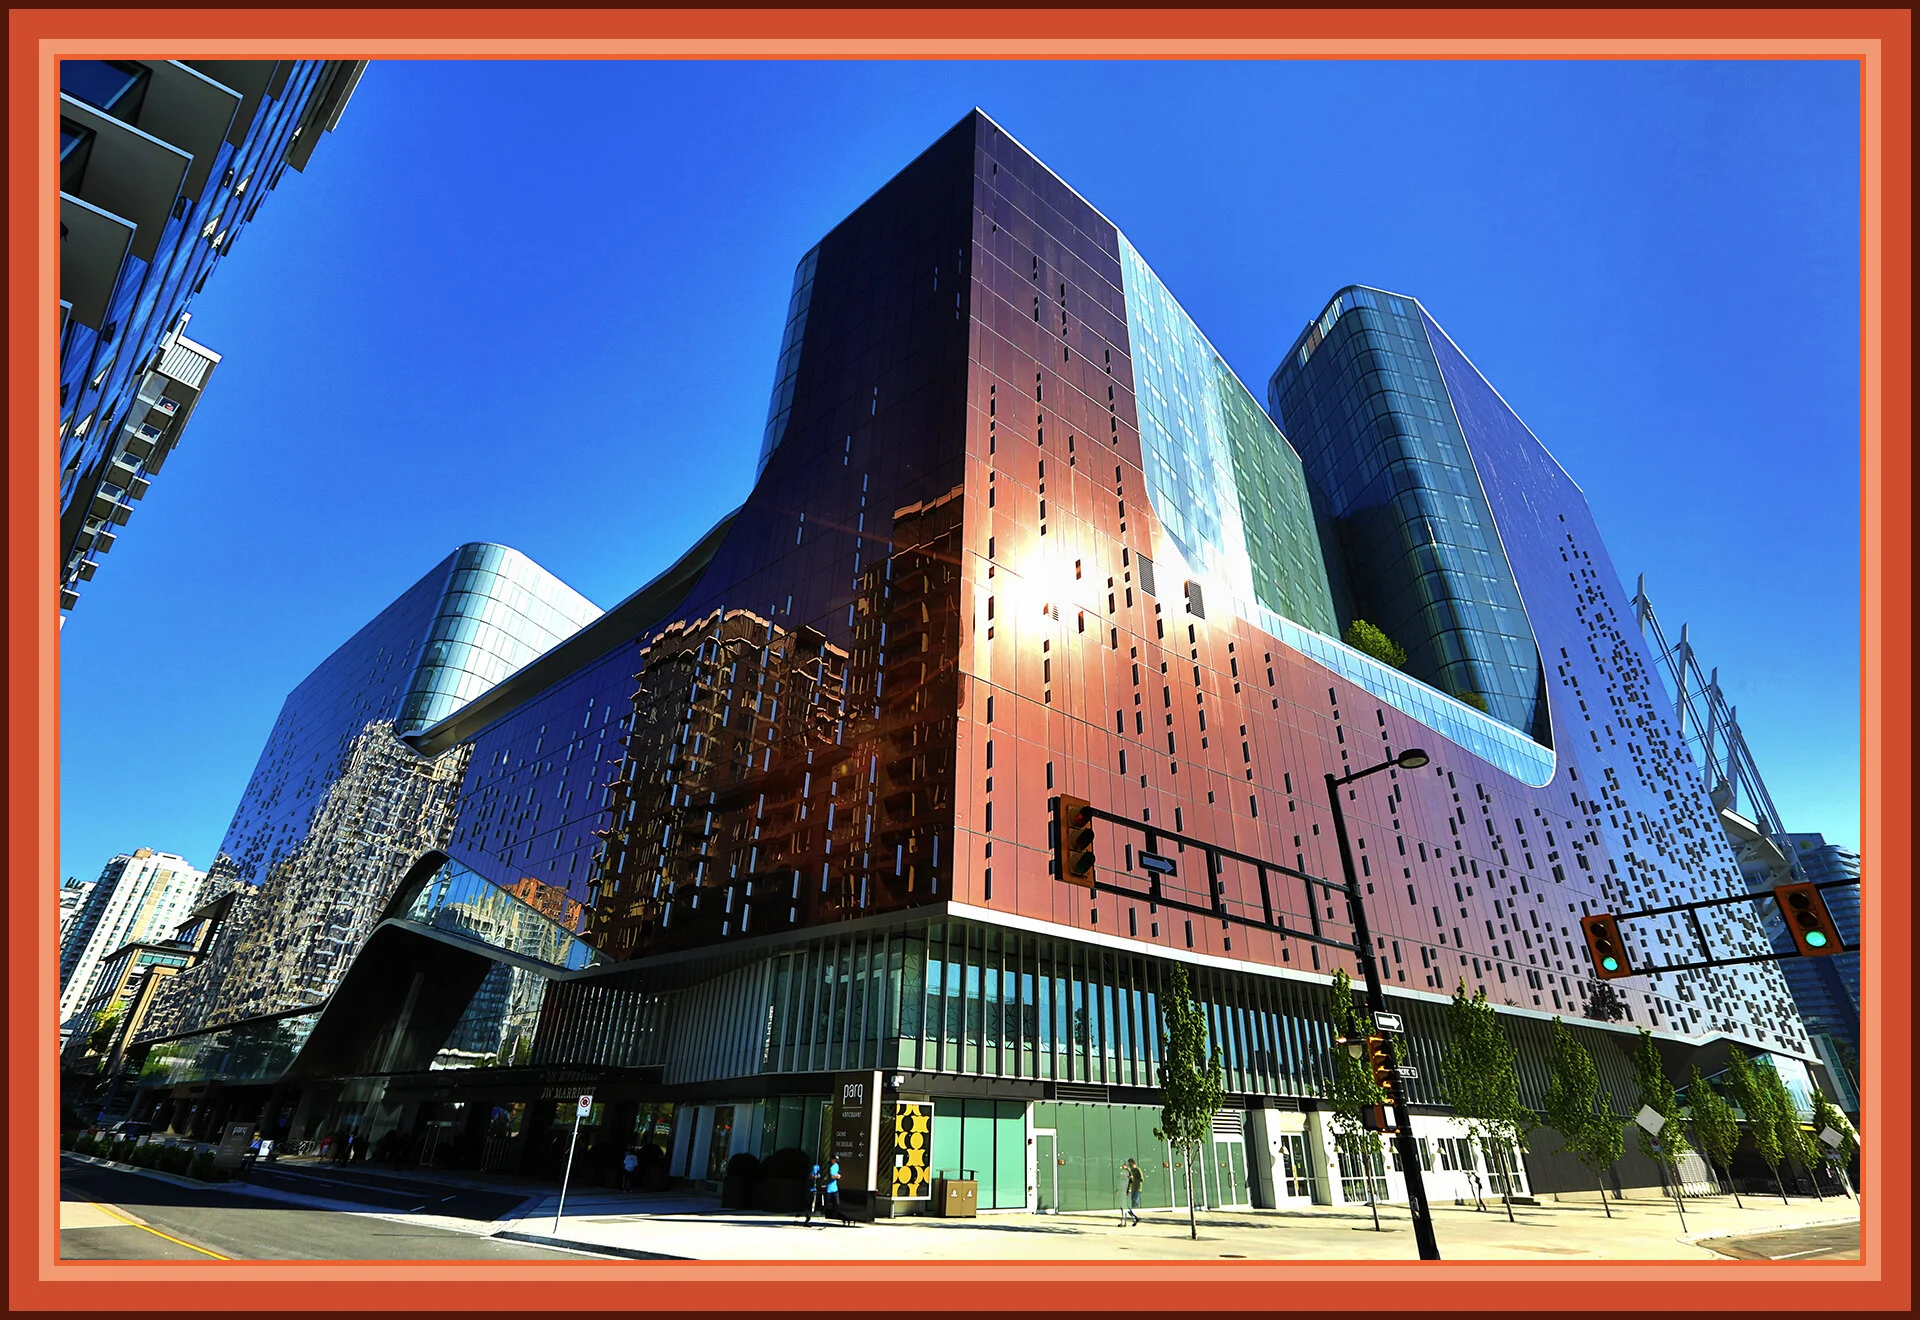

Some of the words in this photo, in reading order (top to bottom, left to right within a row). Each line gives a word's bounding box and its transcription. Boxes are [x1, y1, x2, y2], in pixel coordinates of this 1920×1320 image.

[541, 1087, 553, 1099] JW
[554, 1086, 596, 1099] MARRIOTT
[843, 1083, 863, 1105] parq
[232, 1126, 247, 1136] parq
